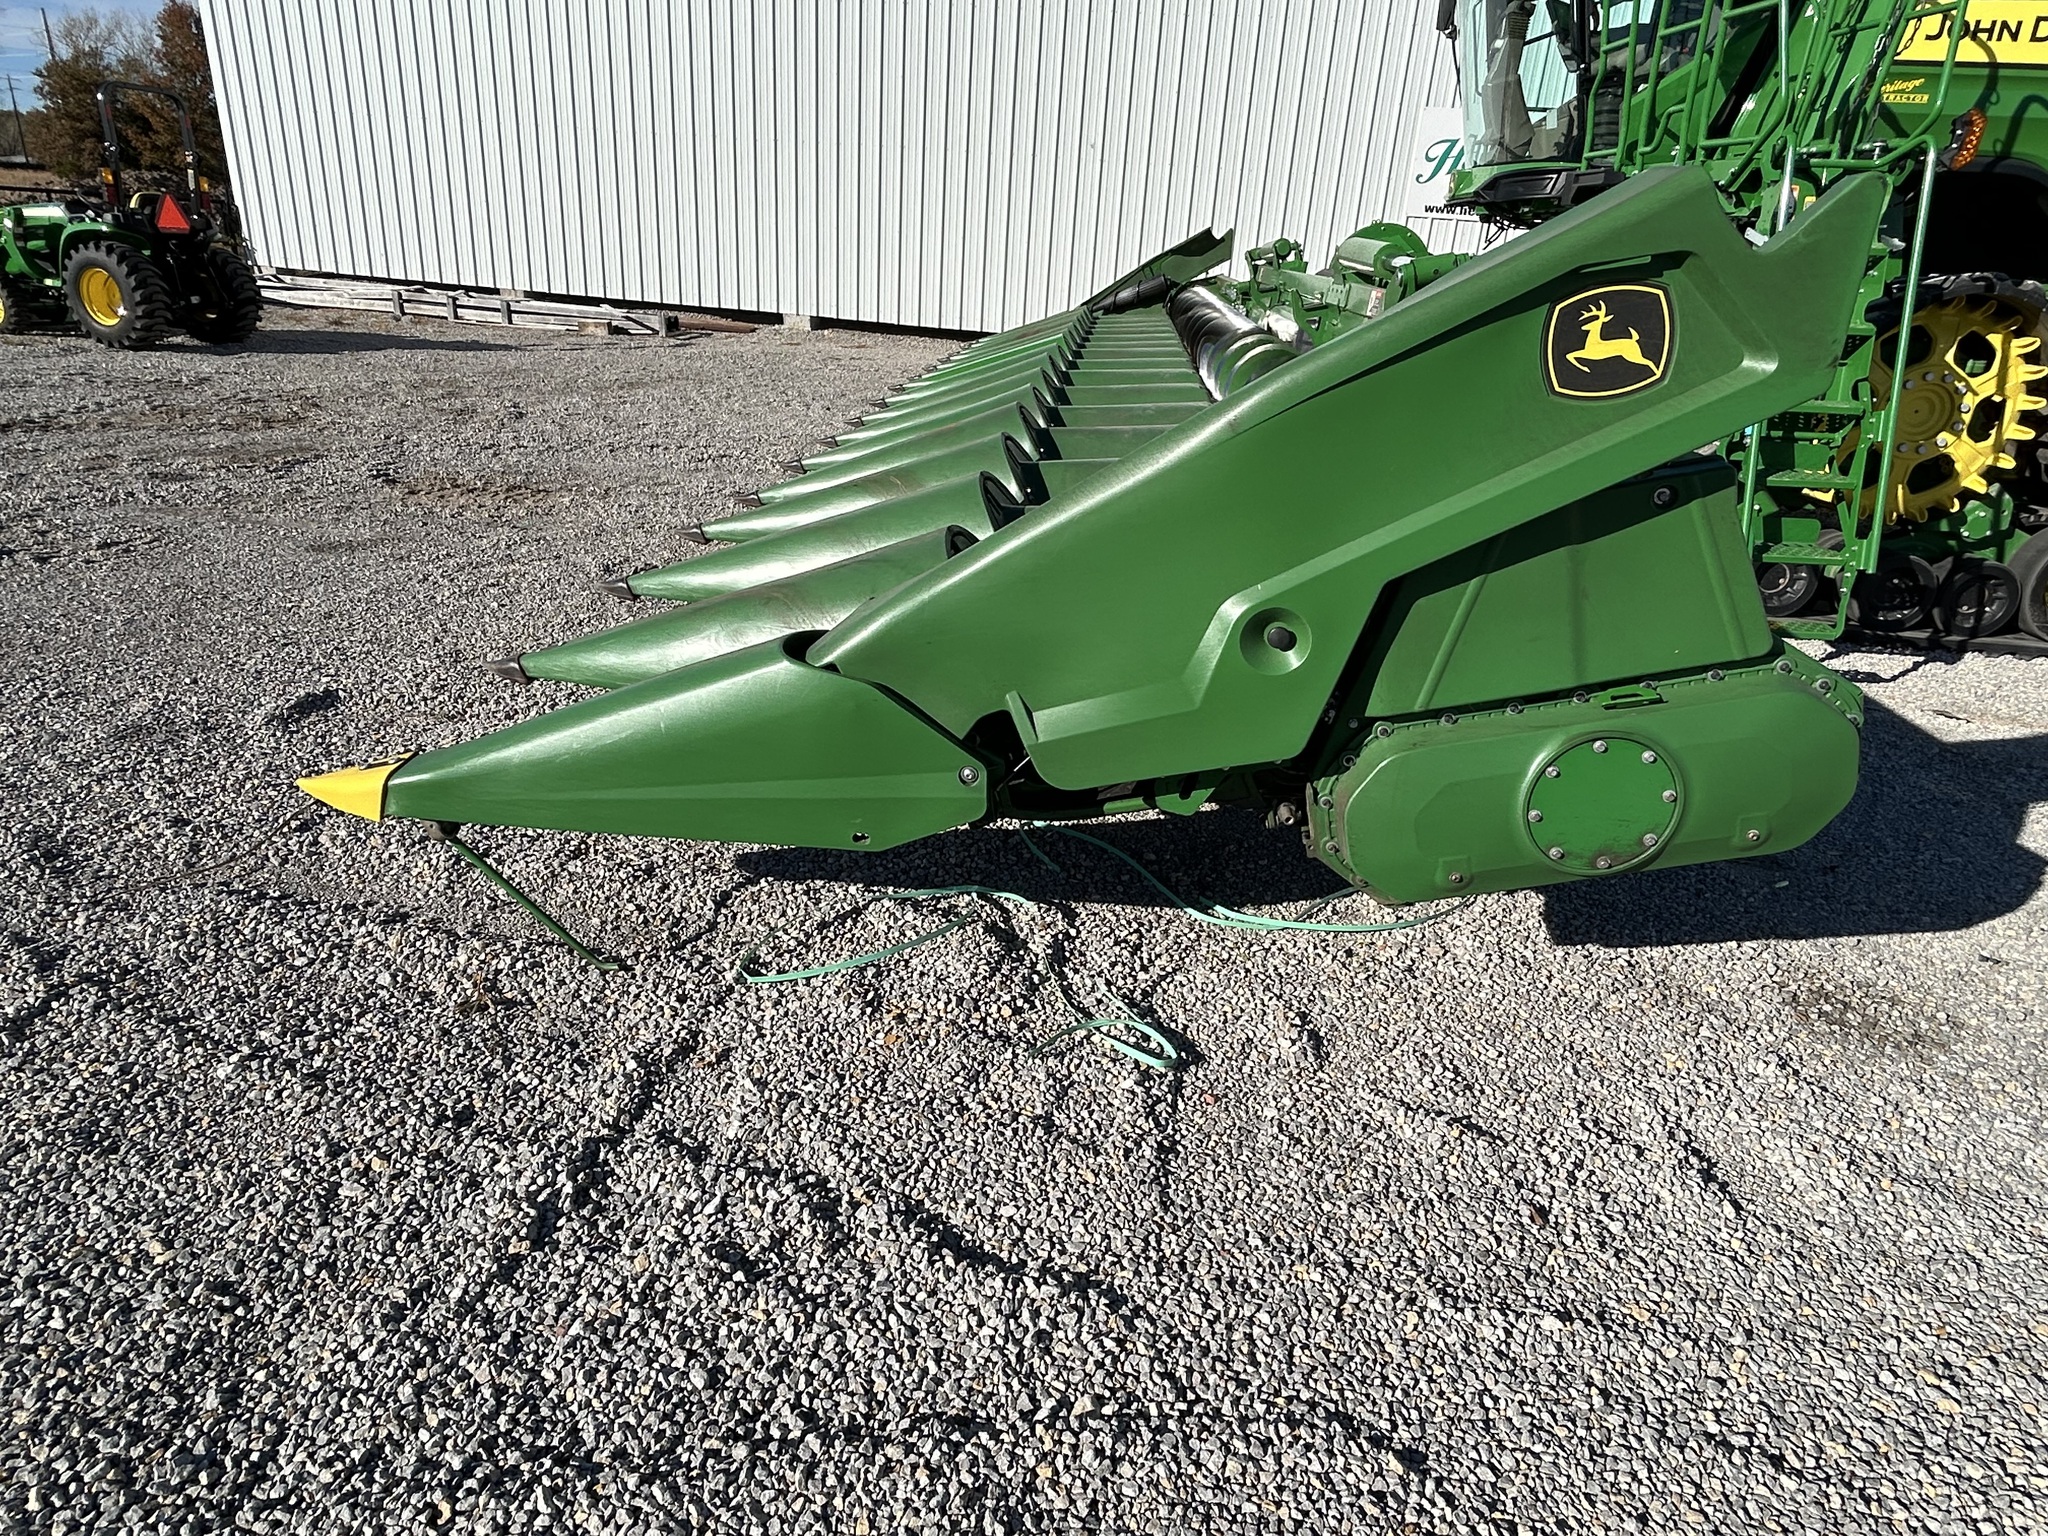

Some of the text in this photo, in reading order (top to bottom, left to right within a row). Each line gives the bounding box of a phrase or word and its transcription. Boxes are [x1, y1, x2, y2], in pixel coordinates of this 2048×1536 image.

[1924, 12, 2024, 43] JOHN
[1880, 78, 1925, 94] eritage
[1415, 138, 1466, 184] H
